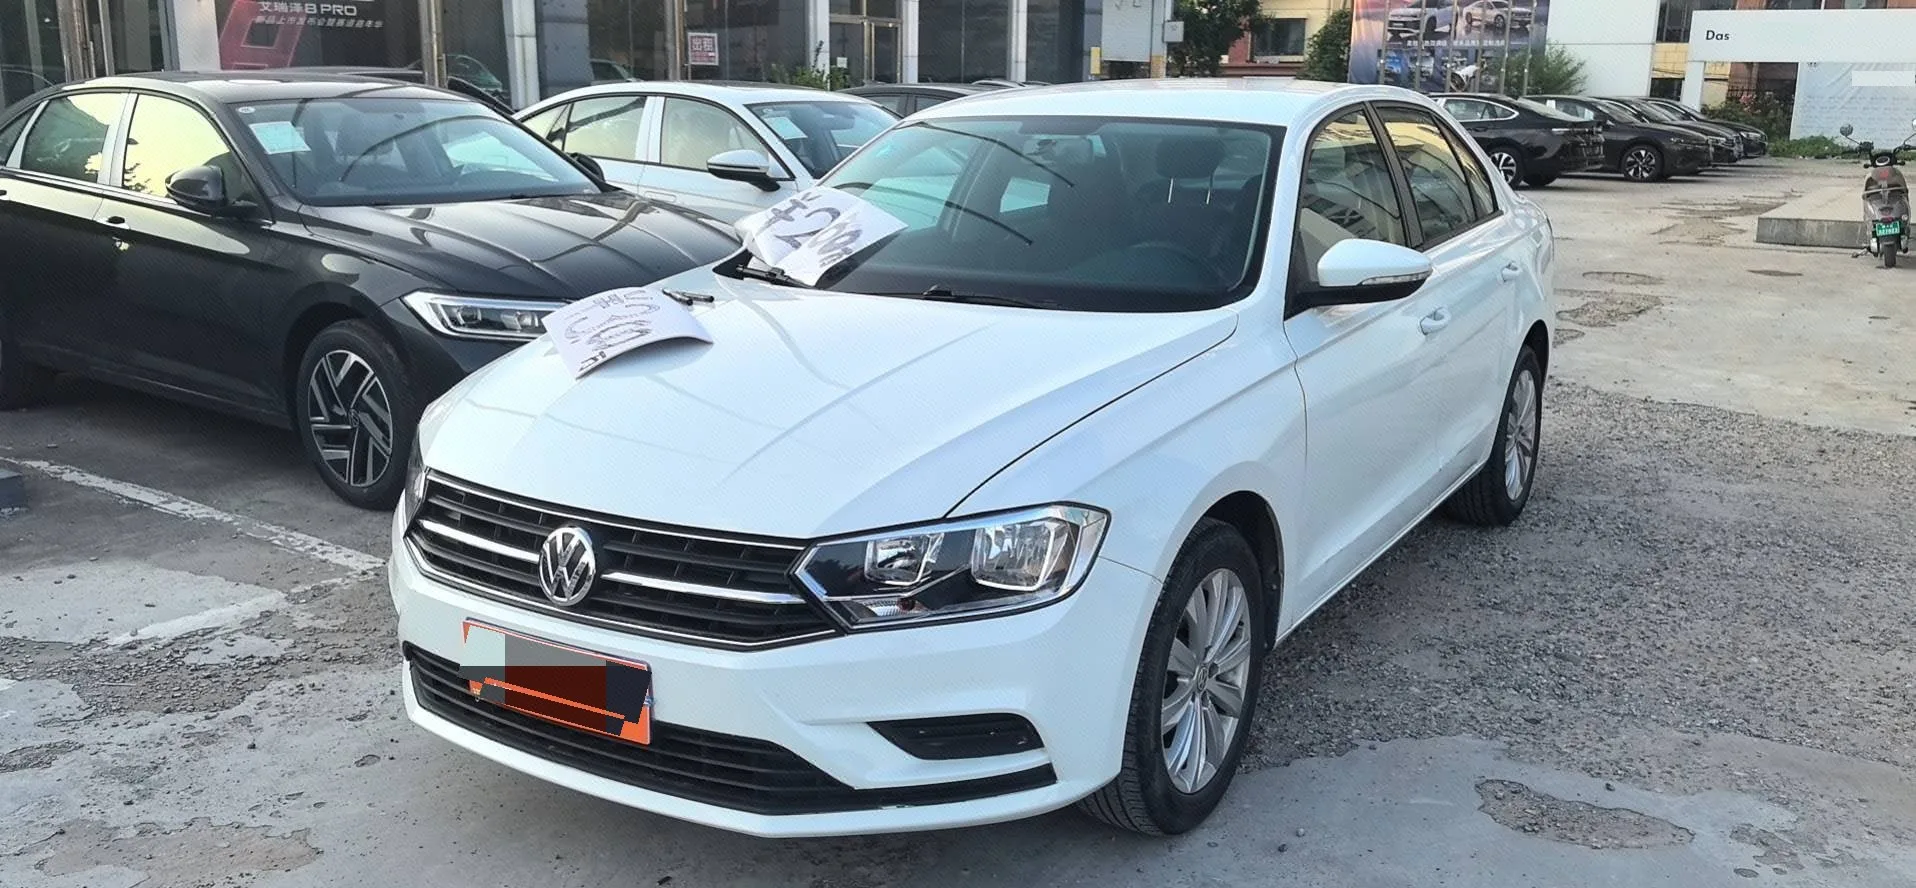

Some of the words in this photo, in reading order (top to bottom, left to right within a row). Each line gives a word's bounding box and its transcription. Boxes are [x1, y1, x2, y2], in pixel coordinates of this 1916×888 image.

[320, 4, 357, 16] PRO
[1706, 29, 1730, 41] Das
[692, 37, 714, 51] 出租
